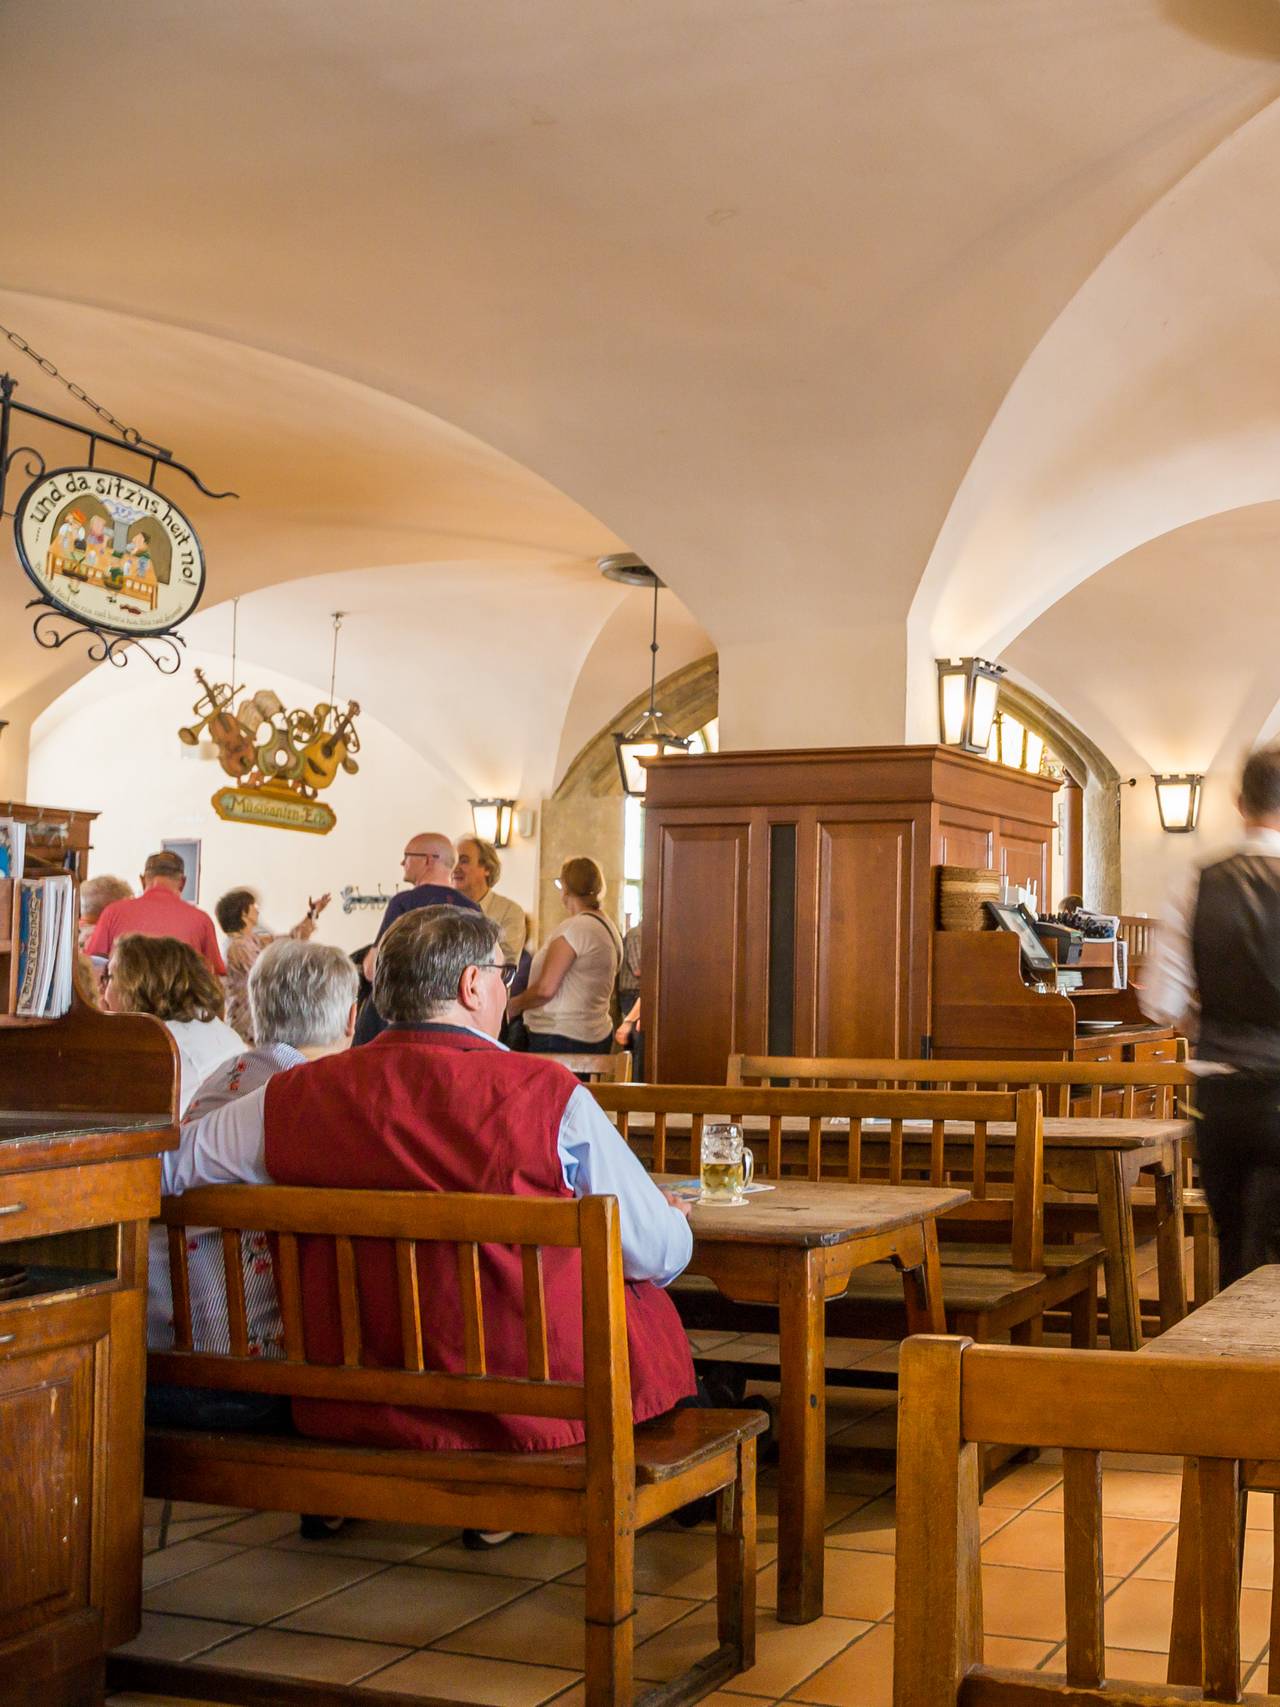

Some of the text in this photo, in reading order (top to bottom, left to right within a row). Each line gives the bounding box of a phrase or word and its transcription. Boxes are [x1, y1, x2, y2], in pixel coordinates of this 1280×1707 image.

[65, 472, 91, 493] da
[161, 503, 191, 546] heit
[178, 551, 198, 586] no!
